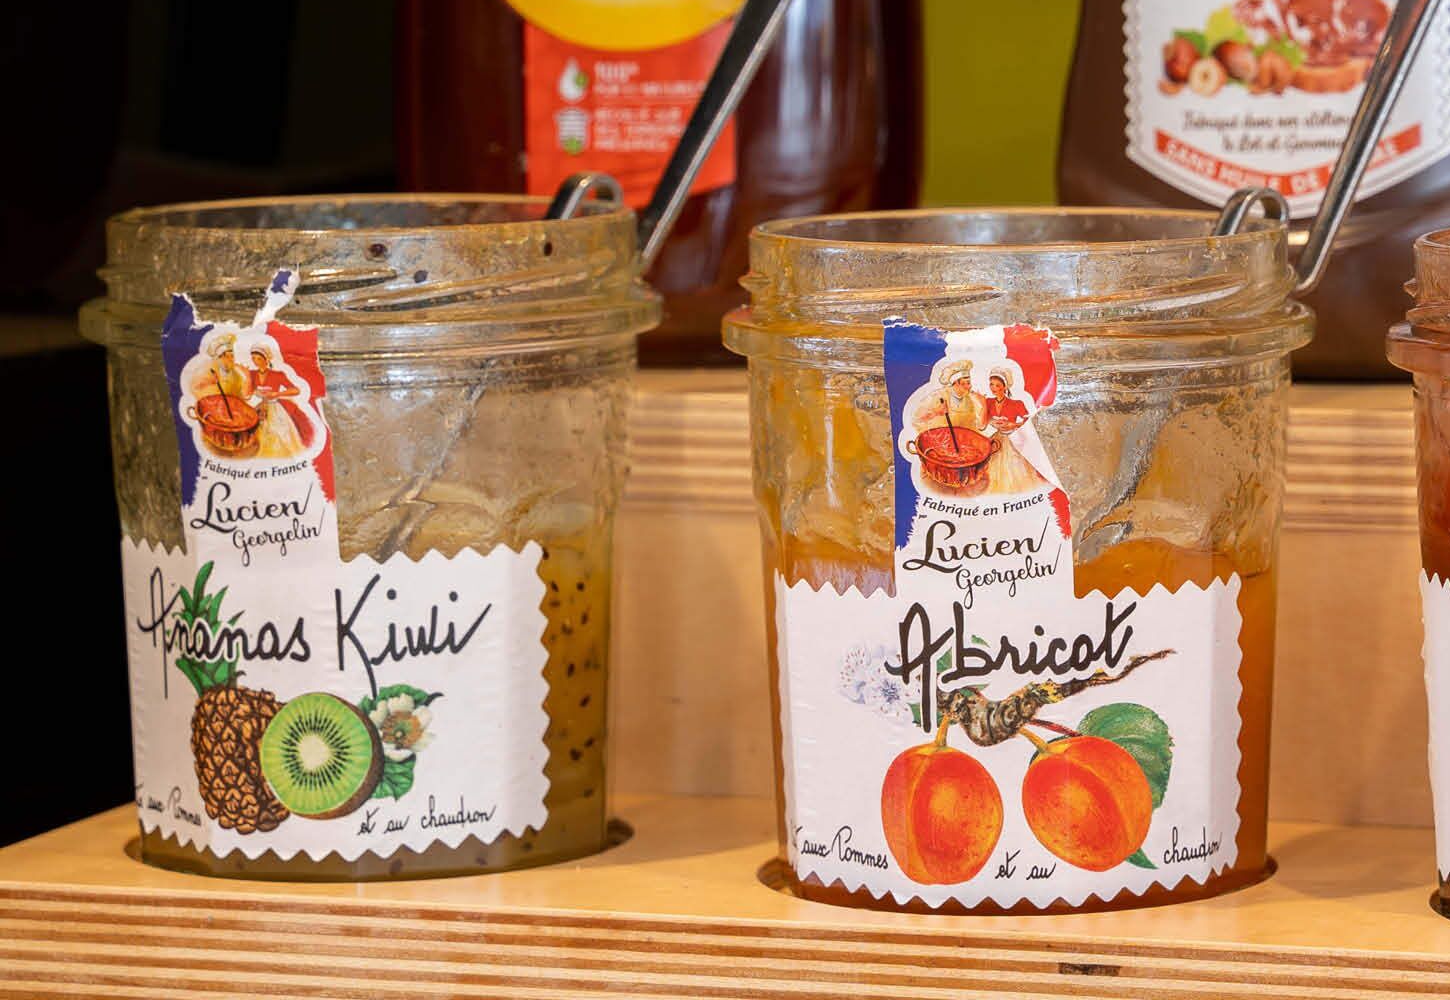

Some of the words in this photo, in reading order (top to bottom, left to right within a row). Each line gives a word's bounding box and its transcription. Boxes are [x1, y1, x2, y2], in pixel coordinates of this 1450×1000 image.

[205, 459, 251, 480] Fabriqué
[254, 468, 268, 480] en
[270, 458, 308, 479] France
[190, 481, 313, 534] Lucien
[922, 496, 980, 519] Fabriqué
[983, 504, 999, 517] en
[1003, 491, 1044, 513] France
[232, 509, 325, 566] Georgelin
[902, 516, 1051, 574] Lucien
[955, 542, 1062, 609] Georgelin
[137, 566, 311, 698] Ananas
[335, 574, 492, 699] Kiwi
[884, 600, 1137, 733] Abricot
[357, 806, 379, 835] et
[384, 813, 410, 835] au
[421, 795, 497, 831] chaudron
[801, 840, 830, 858] aux
[831, 825, 889, 870] Pommes
[994, 848, 1021, 881] et
[1025, 861, 1057, 882] au
